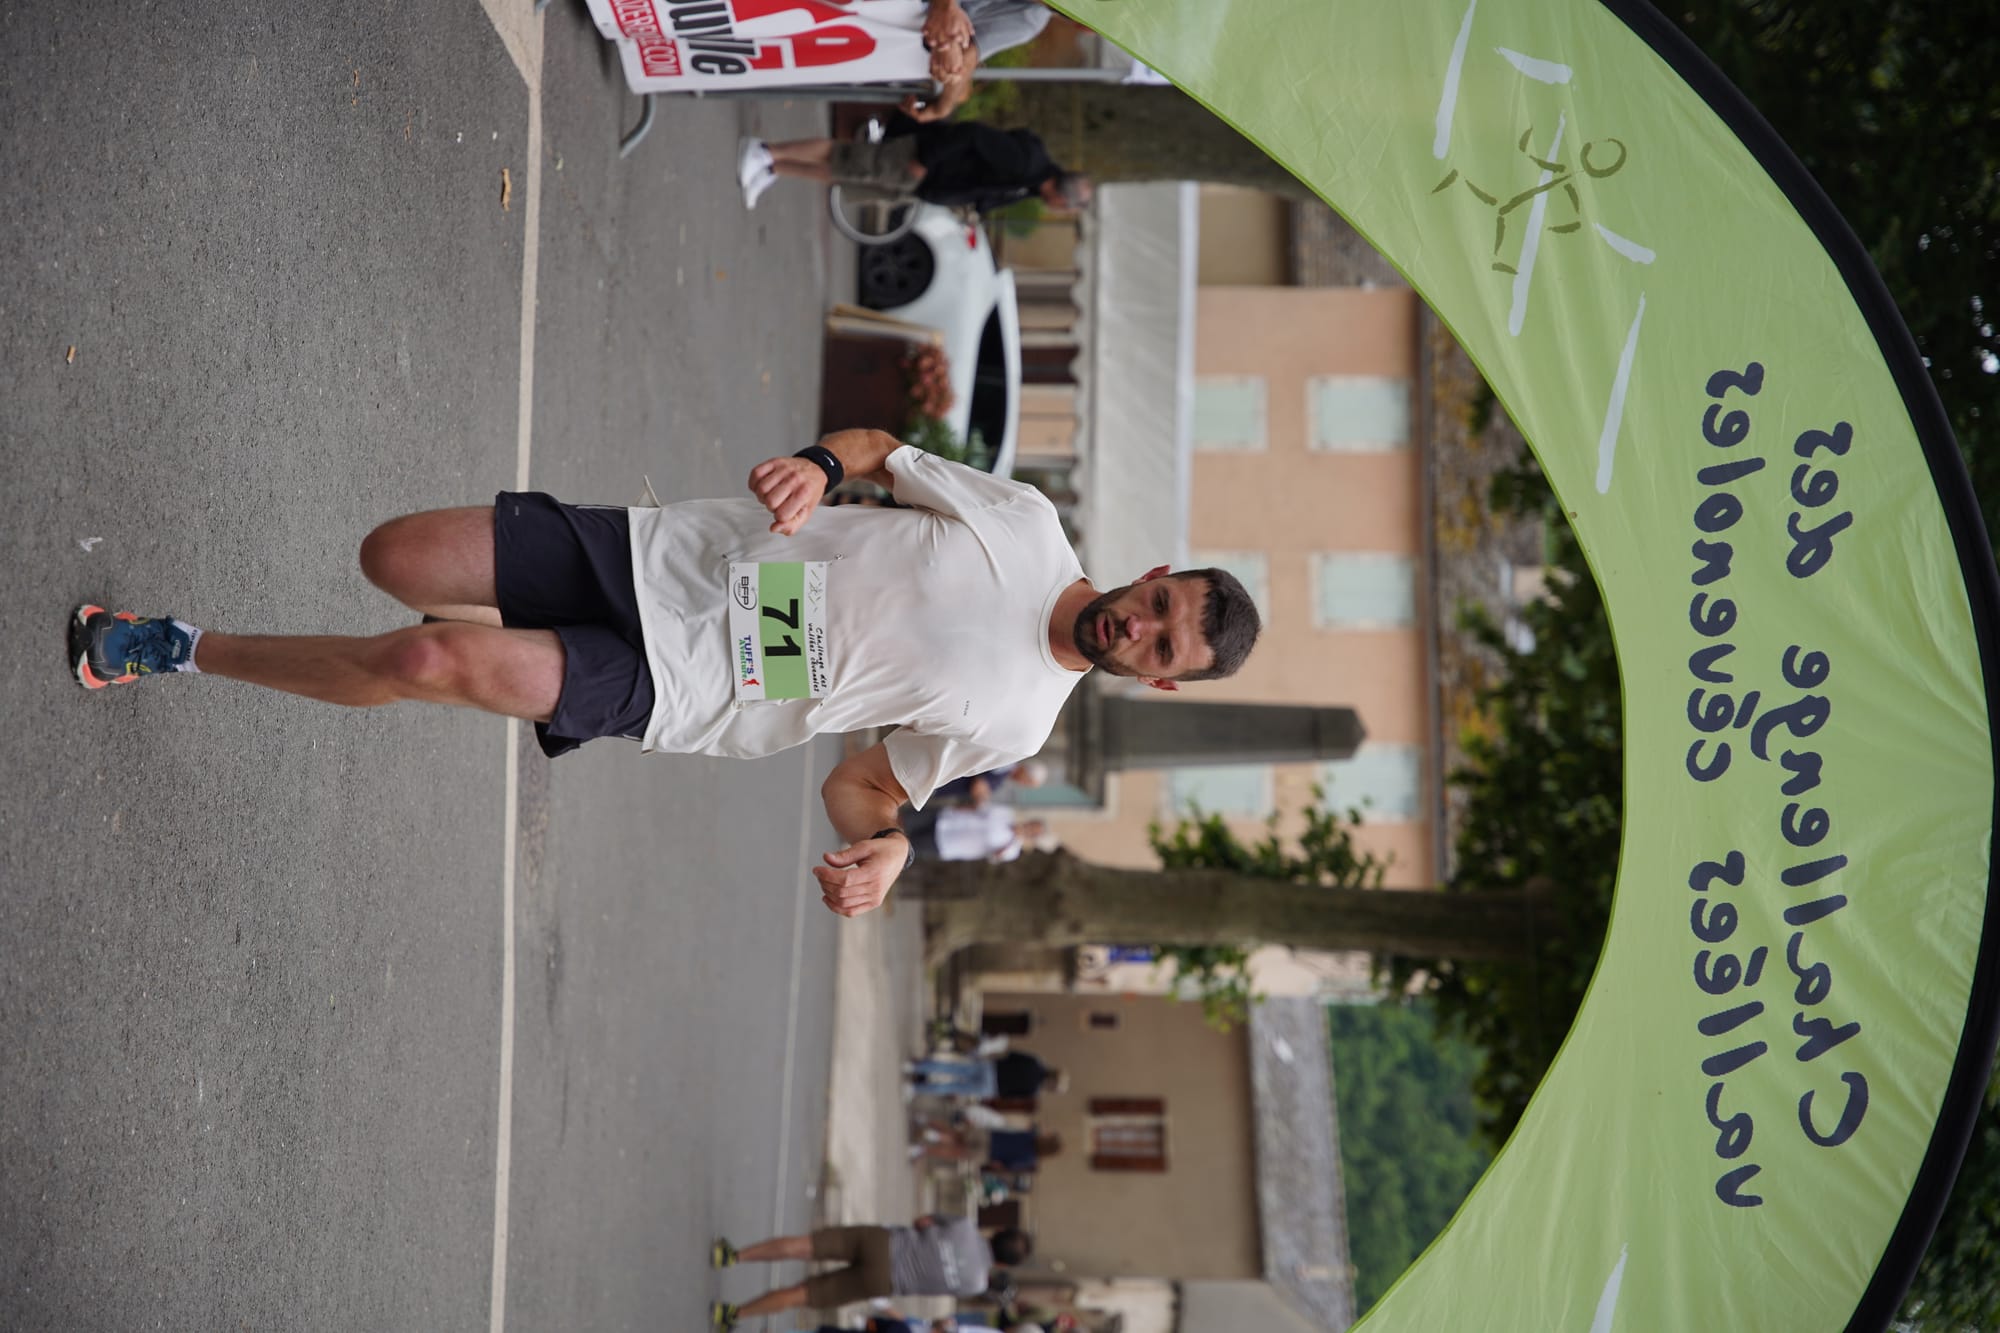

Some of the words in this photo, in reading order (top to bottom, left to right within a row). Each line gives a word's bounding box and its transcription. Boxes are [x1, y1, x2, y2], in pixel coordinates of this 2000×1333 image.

[741, 576, 749, 605] BFP
[762, 598, 802, 657] 71
[739, 639, 748, 678] Aventure
[743, 635, 754, 674] TUFF'S
[815, 627, 825, 669] Challenge
[819, 674, 827, 688] des
